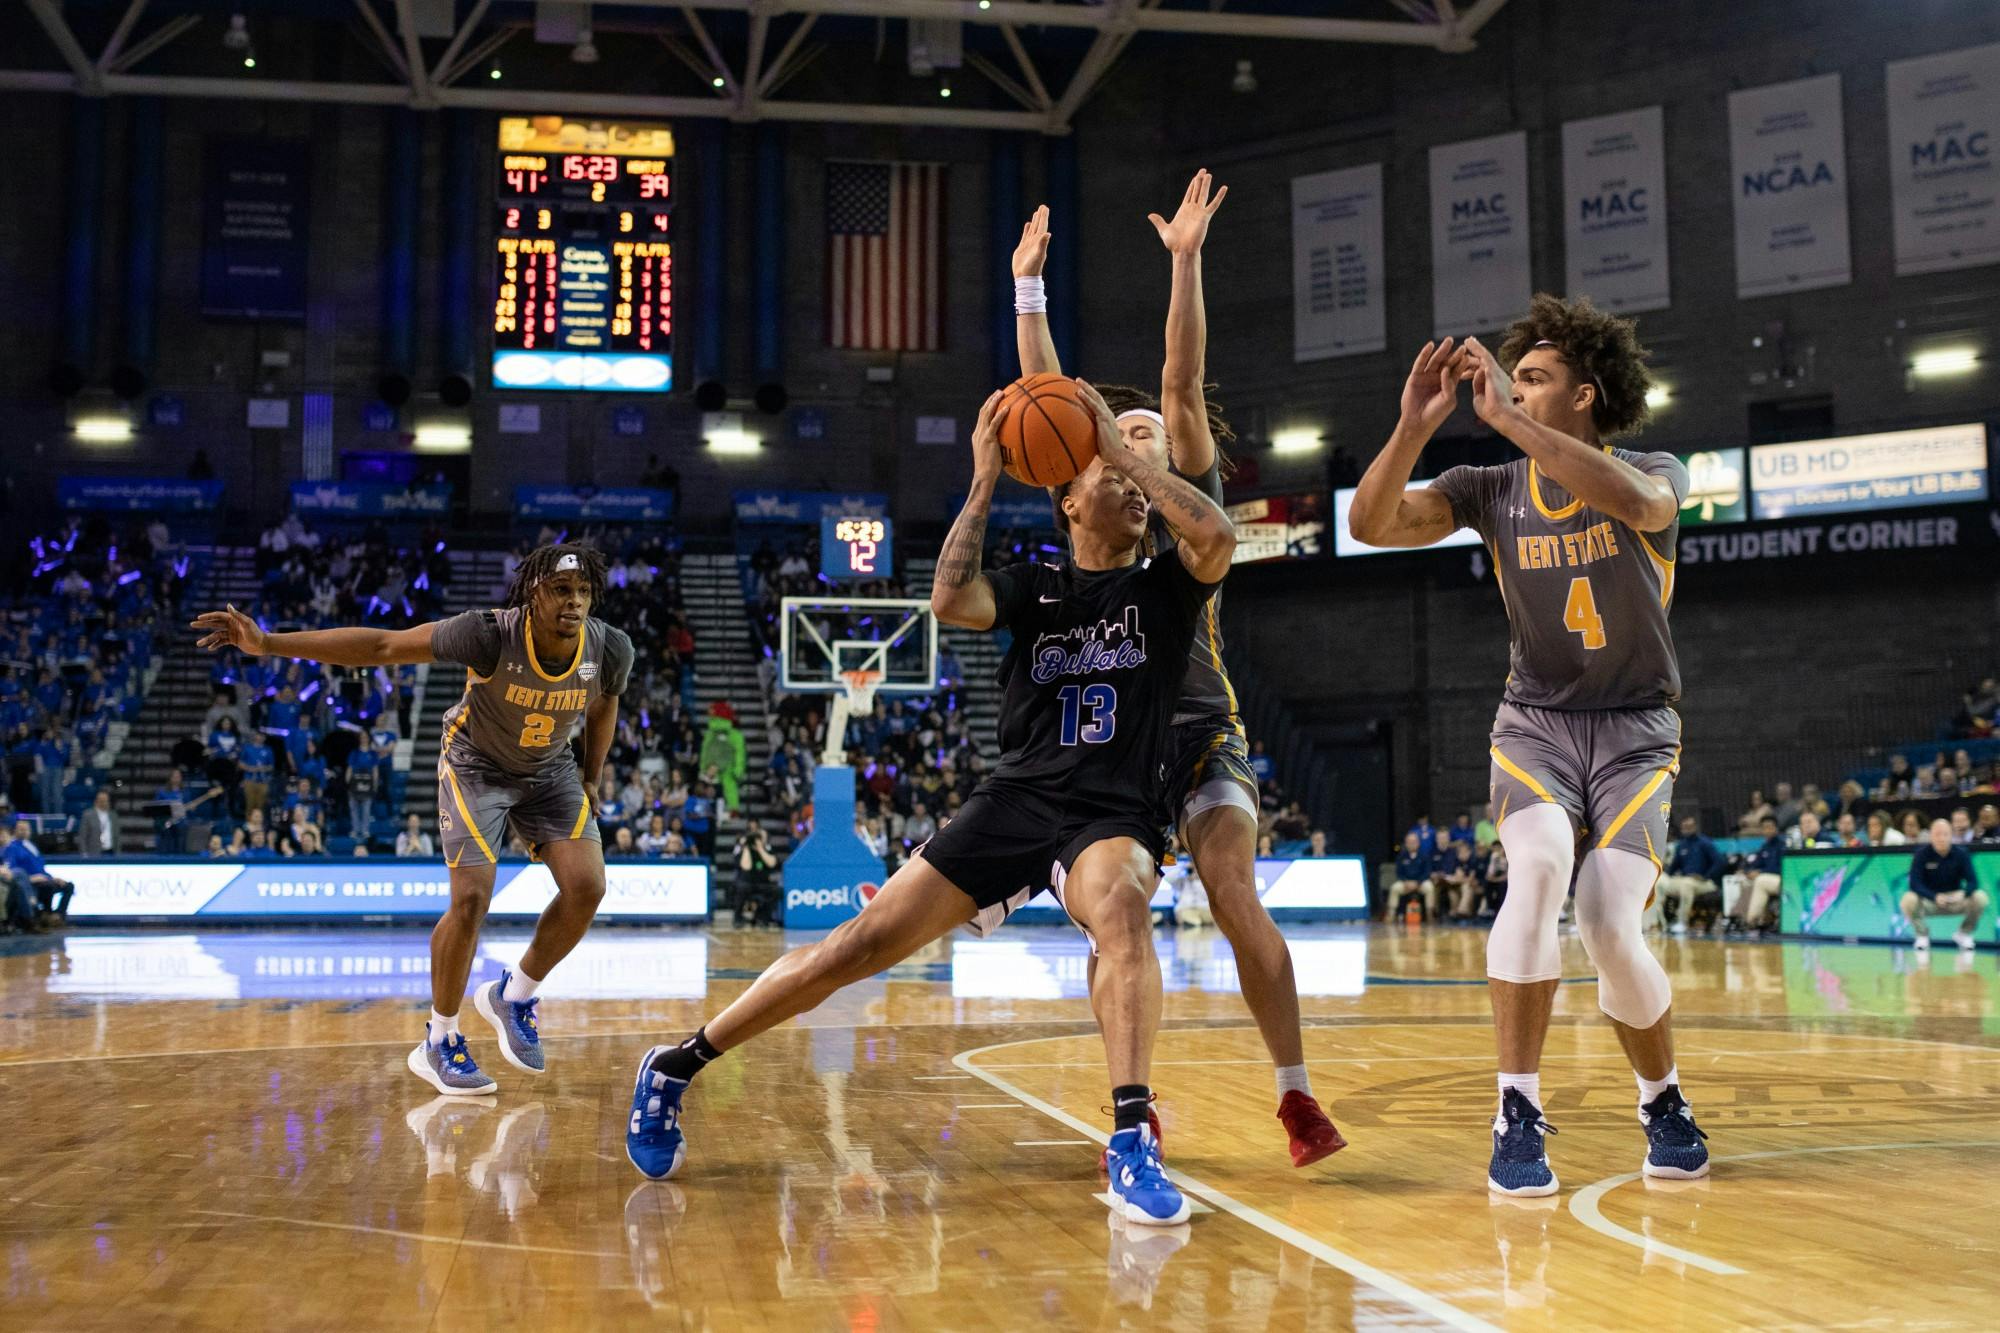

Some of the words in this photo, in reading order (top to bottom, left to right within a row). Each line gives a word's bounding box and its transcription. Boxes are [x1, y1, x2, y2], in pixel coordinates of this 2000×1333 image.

[1910, 131, 1989, 166] MAC
[507, 171, 537, 193] 41
[563, 156, 618, 181] 15:23
[1742, 161, 1835, 197] NCAA
[592, 182, 606, 203] 2
[640, 174, 669, 198] 39
[507, 209, 520, 229] 2
[1451, 193, 1505, 219] MAC
[1581, 188, 1648, 219] MAC
[654, 214, 668, 232] 4
[1757, 453, 1799, 479] UB
[1807, 448, 1851, 475] MD
[1516, 535, 1562, 570] KENT
[1561, 521, 1619, 567] STATE
[1680, 525, 1823, 565] STUDENT
[1827, 516, 1960, 553] CORNER
[850, 541, 876, 572] 12
[1562, 576, 1607, 650] 4
[1031, 639, 1147, 684] Buffalo
[504, 683, 546, 710] KENT
[544, 689, 588, 711] STATE
[1056, 683, 1118, 746] 13
[519, 713, 557, 748] 2
[257, 882, 336, 897] TODAY'S
[342, 882, 395, 897] GAME
[401, 882, 450, 897] SPON
[786, 885, 849, 910] pepsi
